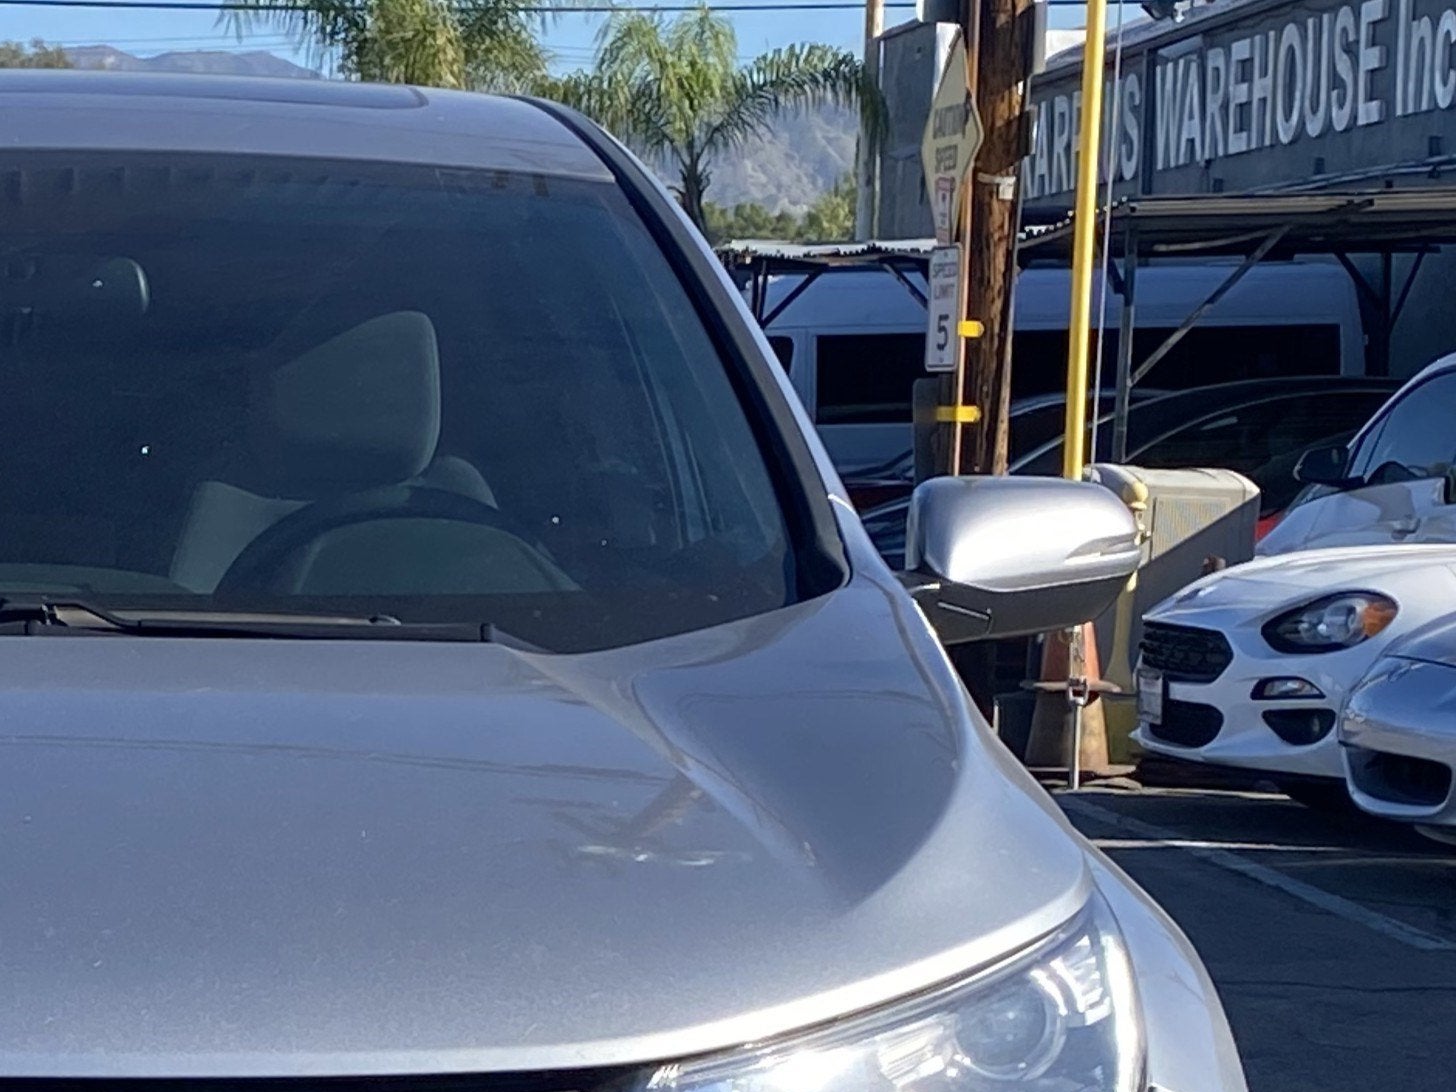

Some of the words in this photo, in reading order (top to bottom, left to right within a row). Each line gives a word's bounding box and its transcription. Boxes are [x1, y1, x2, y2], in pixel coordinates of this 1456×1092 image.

[1155, 0, 1386, 170] WAREHOUSE
[1396, 0, 1456, 117] Inc
[936, 314, 949, 351] 5
